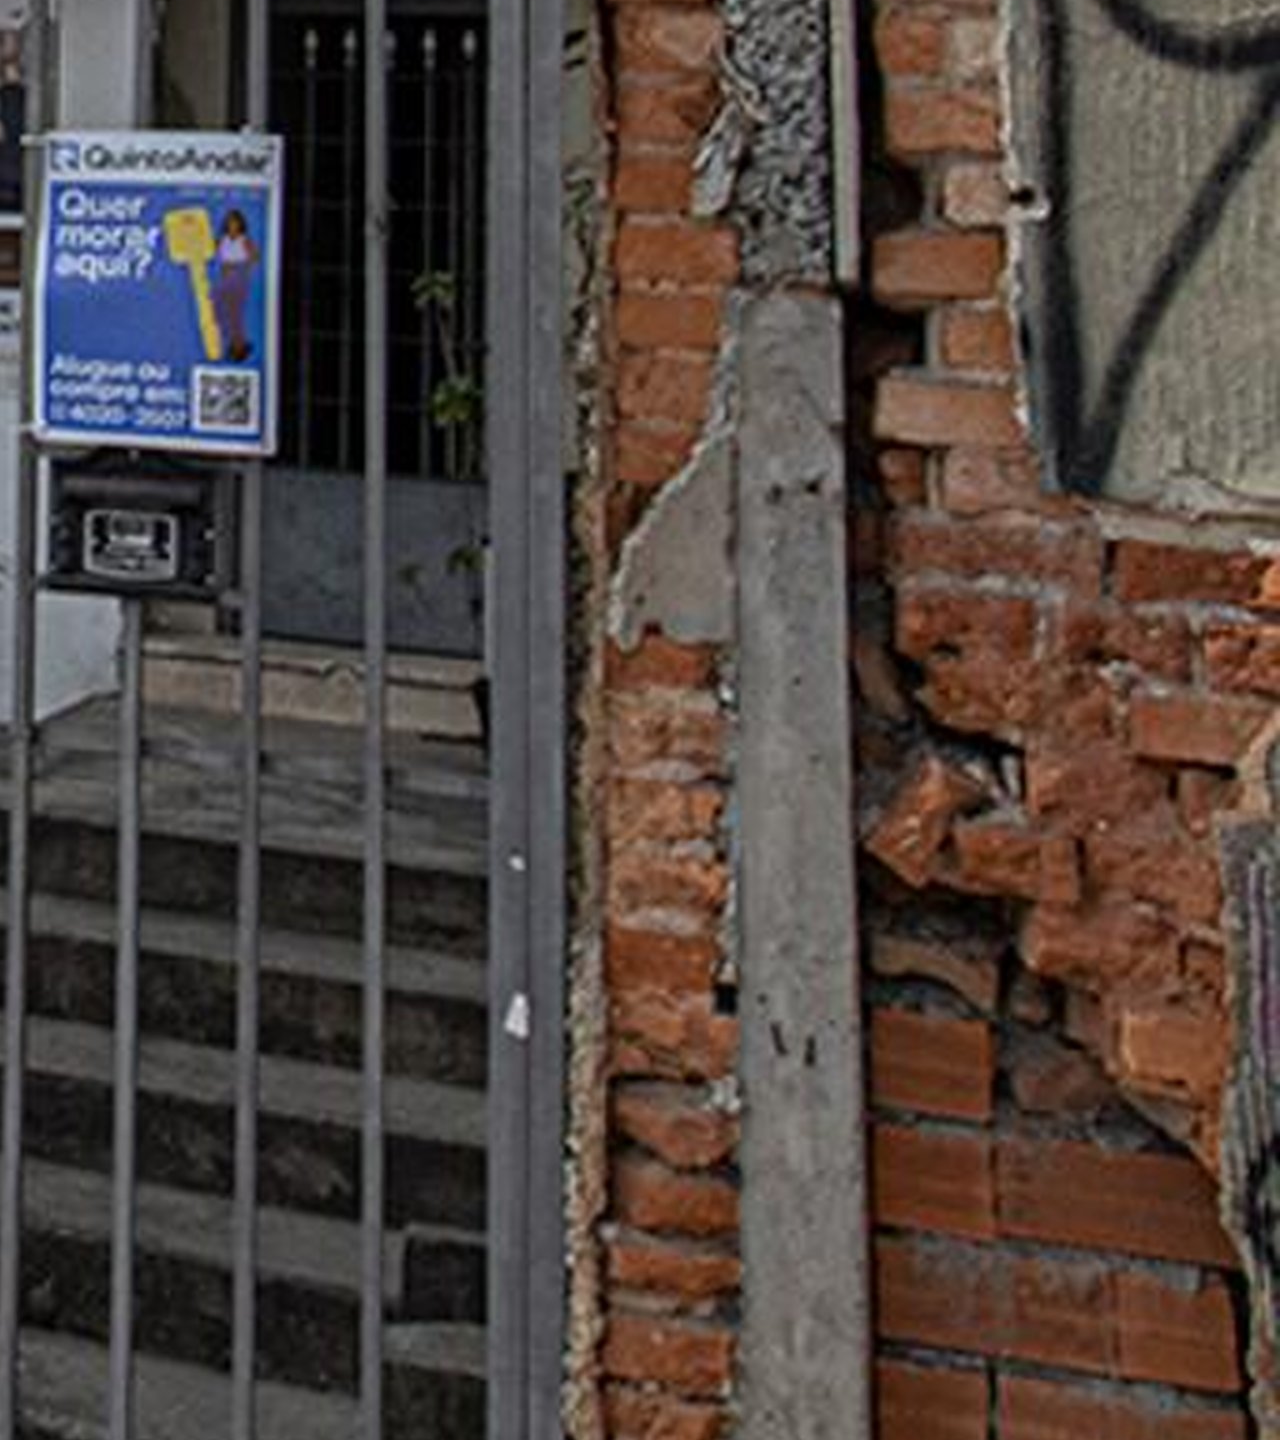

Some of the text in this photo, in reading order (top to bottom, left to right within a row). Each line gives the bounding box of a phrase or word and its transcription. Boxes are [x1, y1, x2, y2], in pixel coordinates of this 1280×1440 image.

[84, 143, 267, 173] QuintoAndar
[58, 188, 147, 221] Quer
[54, 224, 160, 249] morar
[53, 250, 153, 283] aqui?
